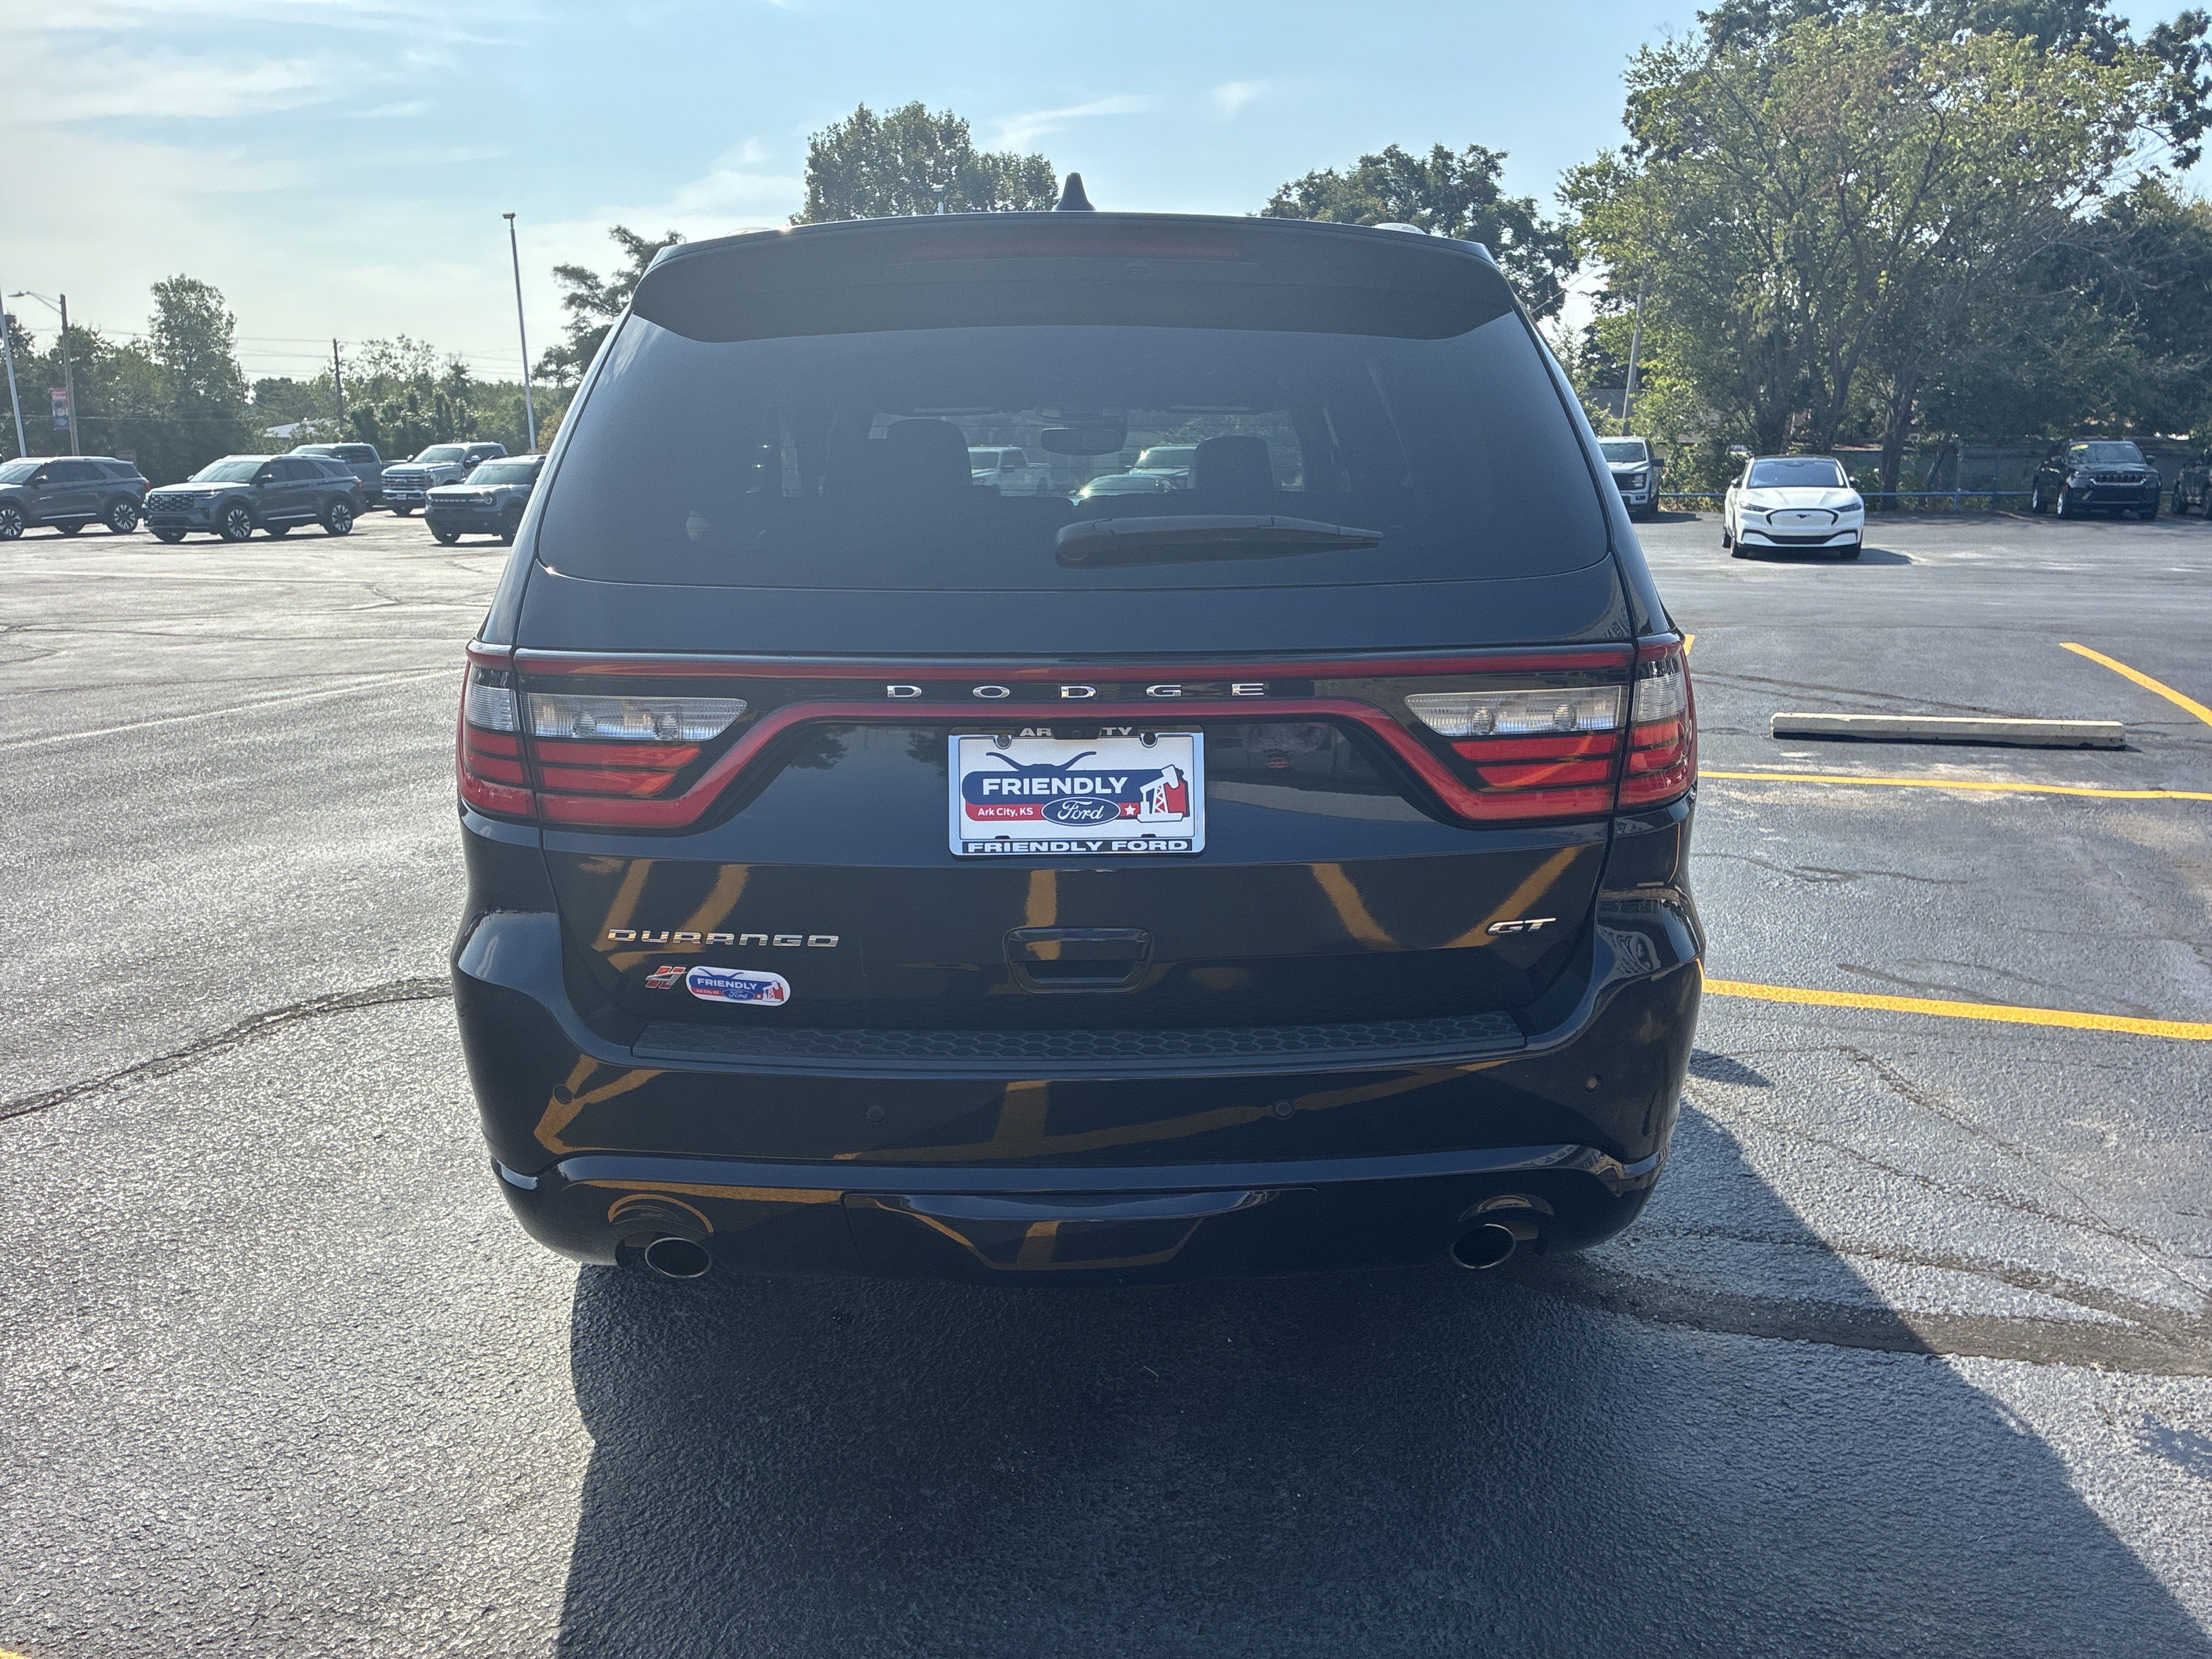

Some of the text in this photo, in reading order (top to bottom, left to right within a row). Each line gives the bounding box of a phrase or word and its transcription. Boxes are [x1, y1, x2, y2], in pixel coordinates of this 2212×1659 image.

[887, 683, 1265, 699] DODGE
[1019, 726, 1133, 736] AR TY
[983, 777, 1128, 795] FRIENDLY
[978, 807, 1034, 816] Ark City, KS
[1057, 800, 1104, 820] Ford
[968, 840, 1188, 853] FRIENDLY FORD
[1488, 917, 1556, 934] GT
[607, 929, 839, 947] DURANGO
[697, 978, 758, 990] FRIENDLY
[728, 990, 748, 999] Ford
